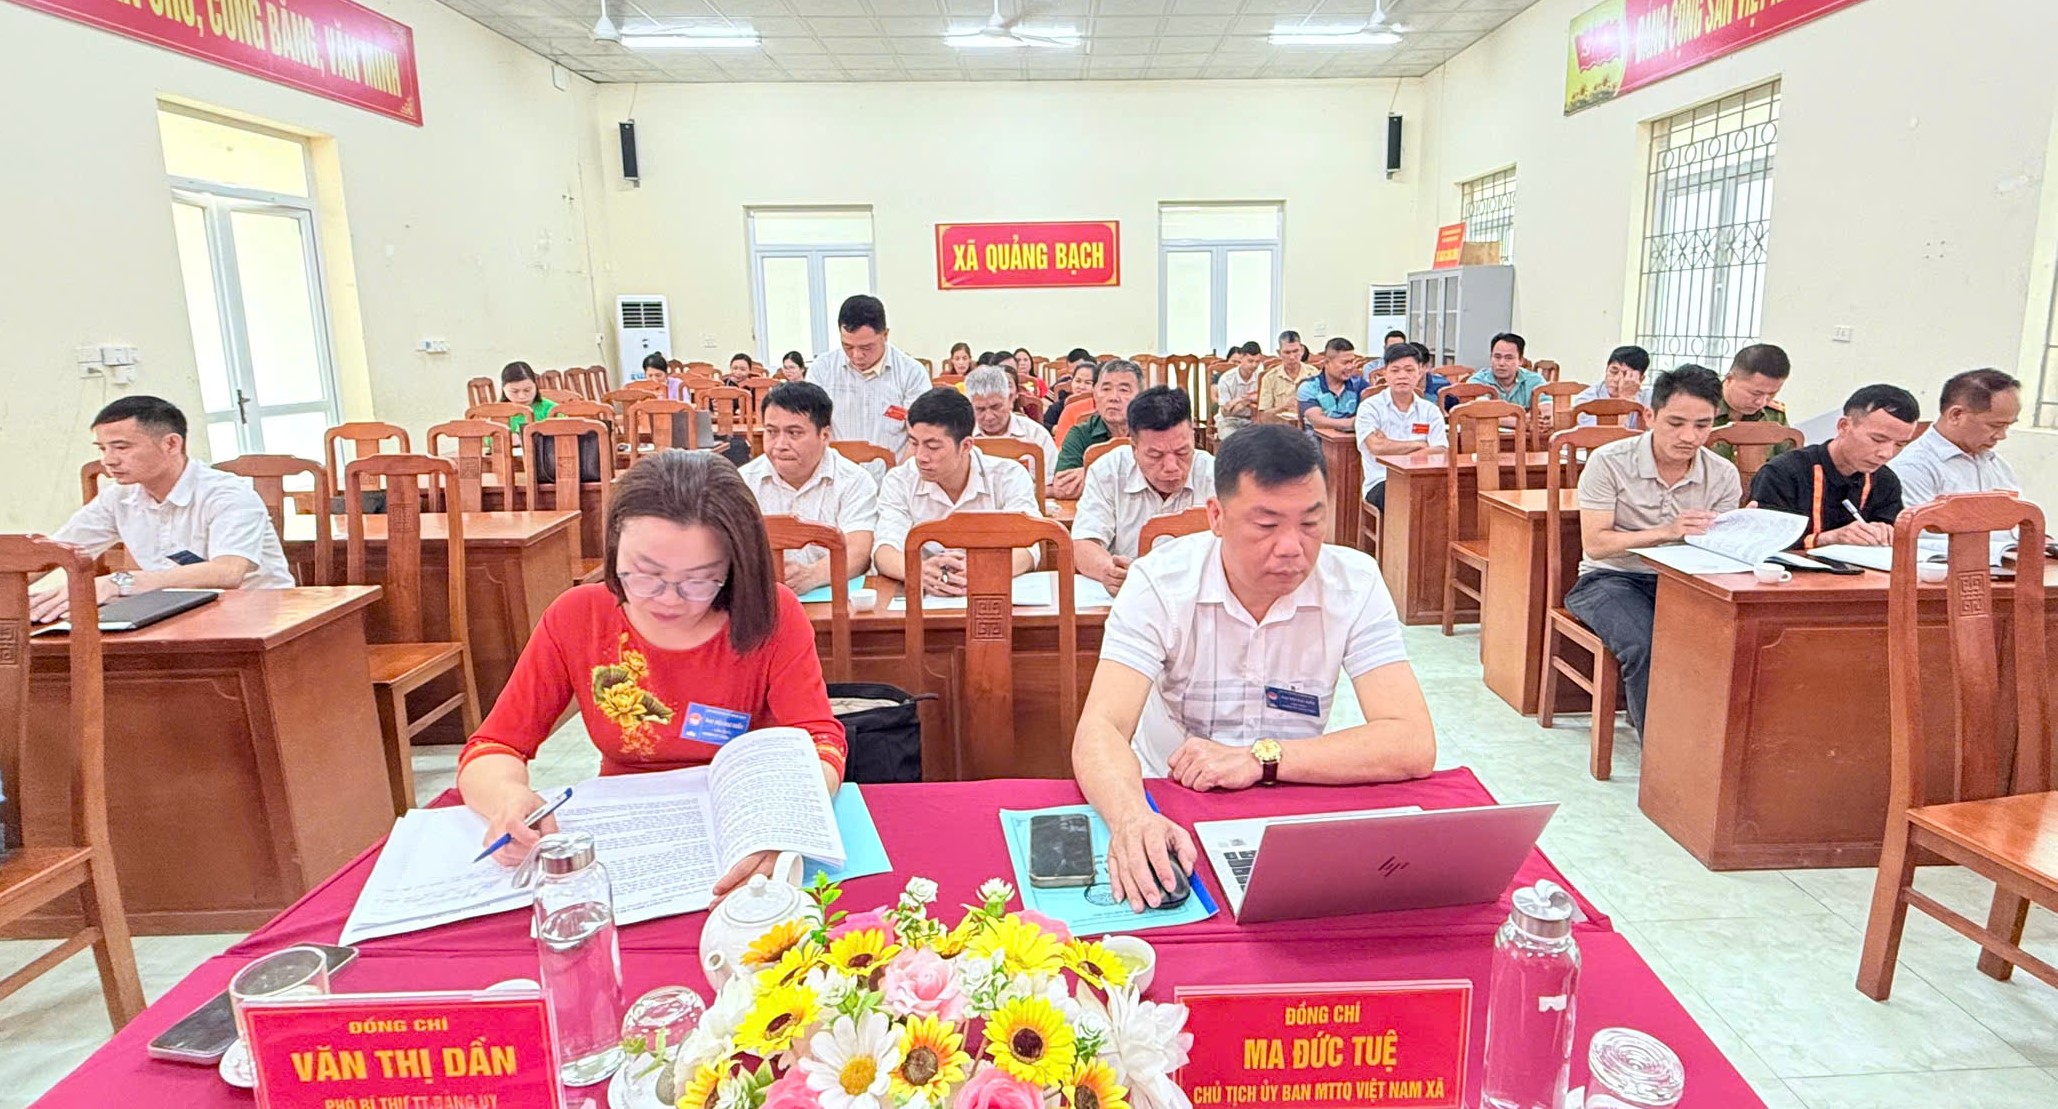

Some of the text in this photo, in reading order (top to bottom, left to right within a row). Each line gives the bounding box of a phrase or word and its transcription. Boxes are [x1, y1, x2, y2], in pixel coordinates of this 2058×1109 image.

[953, 234, 1104, 275] XÃ QUẢNG BẠCH
[414, 1015, 448, 1031] CHÍ
[1333, 1001, 1361, 1023] CHÍ
[290, 1045, 368, 1082] VĂN
[374, 1049, 433, 1084] THỊ
[1244, 1029, 1398, 1072] MA ĐỨC TUỆ
[1194, 1077, 1444, 1106] CHỦ TỊCH ỦY BAN MTTQ VIỆT NAM XÃ
